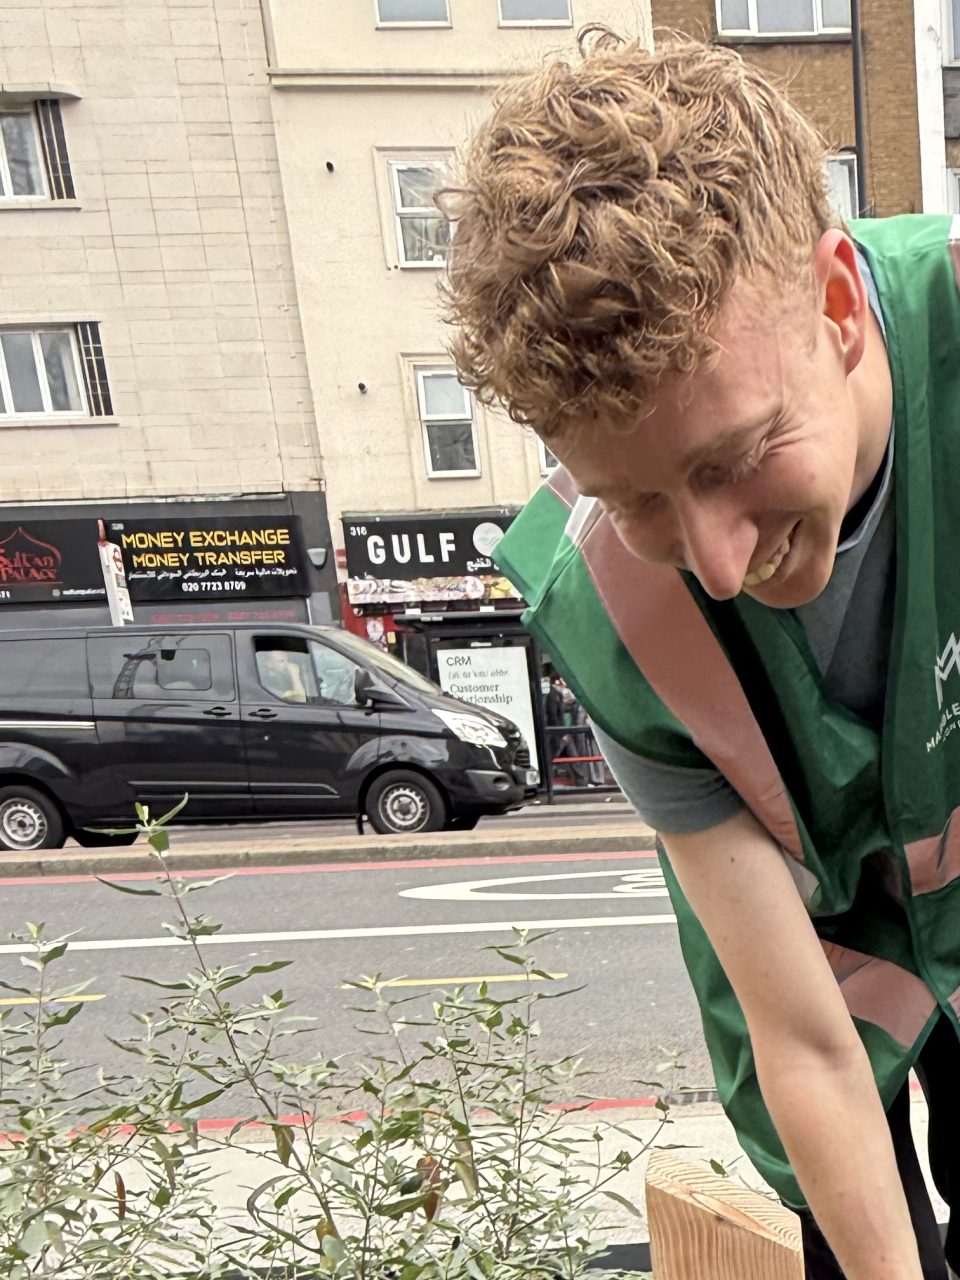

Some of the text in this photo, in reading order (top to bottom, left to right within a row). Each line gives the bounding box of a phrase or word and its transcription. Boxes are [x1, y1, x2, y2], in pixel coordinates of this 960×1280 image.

[121, 528, 291, 549] MONEY EXCHANGE
[366, 532, 456, 565] GULF
[132, 550, 286, 568] MONEY TRANSFER
[446, 655, 472, 667] CRM
[450, 683, 500, 693] Customer
